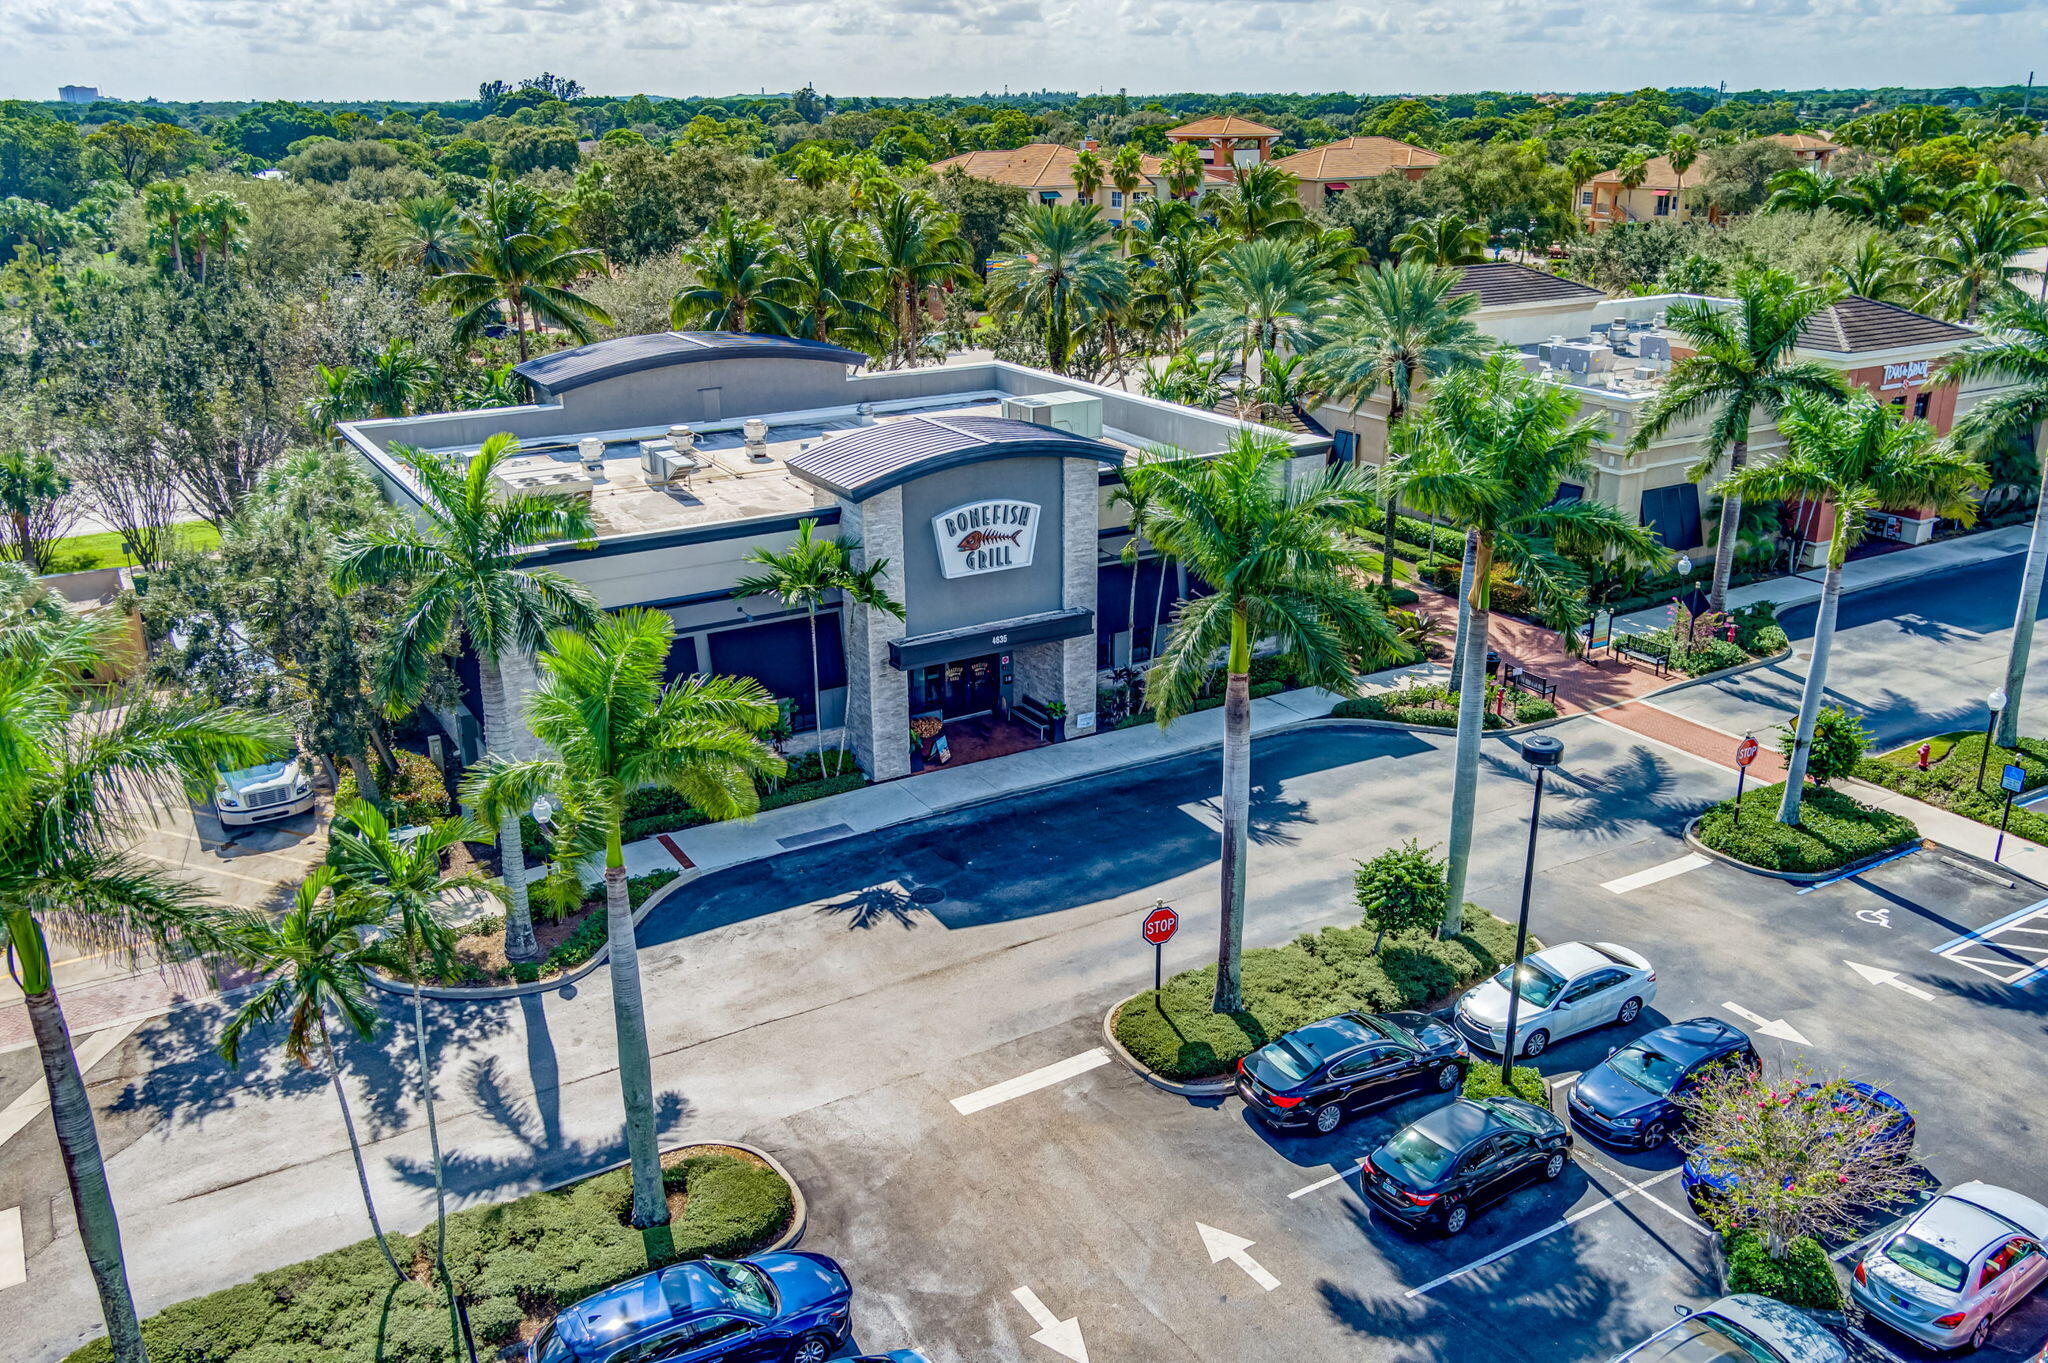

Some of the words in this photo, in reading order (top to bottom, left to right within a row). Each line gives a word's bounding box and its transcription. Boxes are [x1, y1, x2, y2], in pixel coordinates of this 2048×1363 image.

[945, 505, 1031, 537] BONEFISH
[966, 546, 1012, 570] GRILL
[992, 635, 1008, 645] 4635
[1739, 746, 1757, 759] STOP
[1147, 918, 1175, 935] STOP
